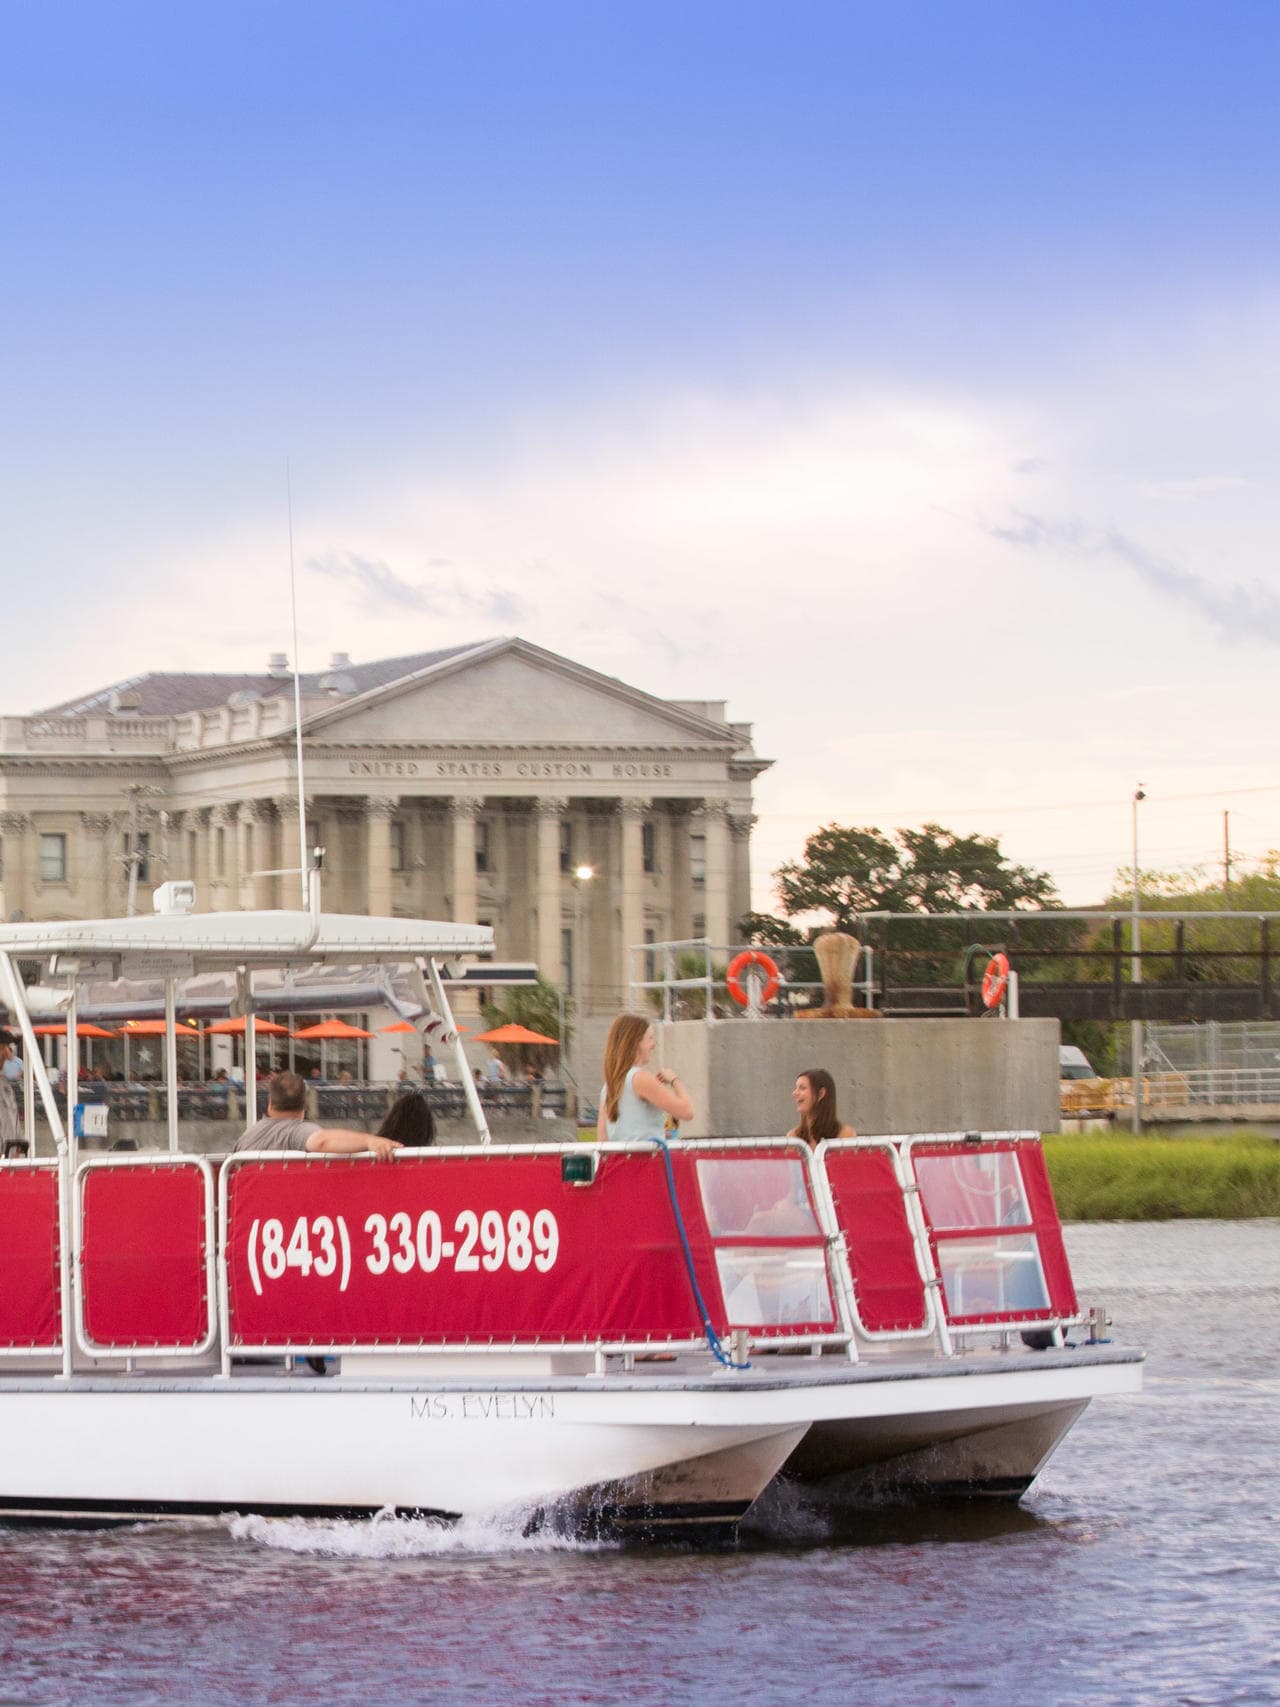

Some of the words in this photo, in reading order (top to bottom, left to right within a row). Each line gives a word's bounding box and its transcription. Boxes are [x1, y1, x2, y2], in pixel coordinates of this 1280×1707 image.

[348, 762, 419, 775] UNITED
[436, 763, 503, 776] STATES
[516, 763, 592, 776] CUSTOM
[612, 764, 674, 777] HOUSE
[247, 1214, 352, 1297] (843)
[364, 1209, 560, 1275] 330-2989
[410, 1394, 455, 1418] MS.
[462, 1394, 555, 1418] EVELYN
